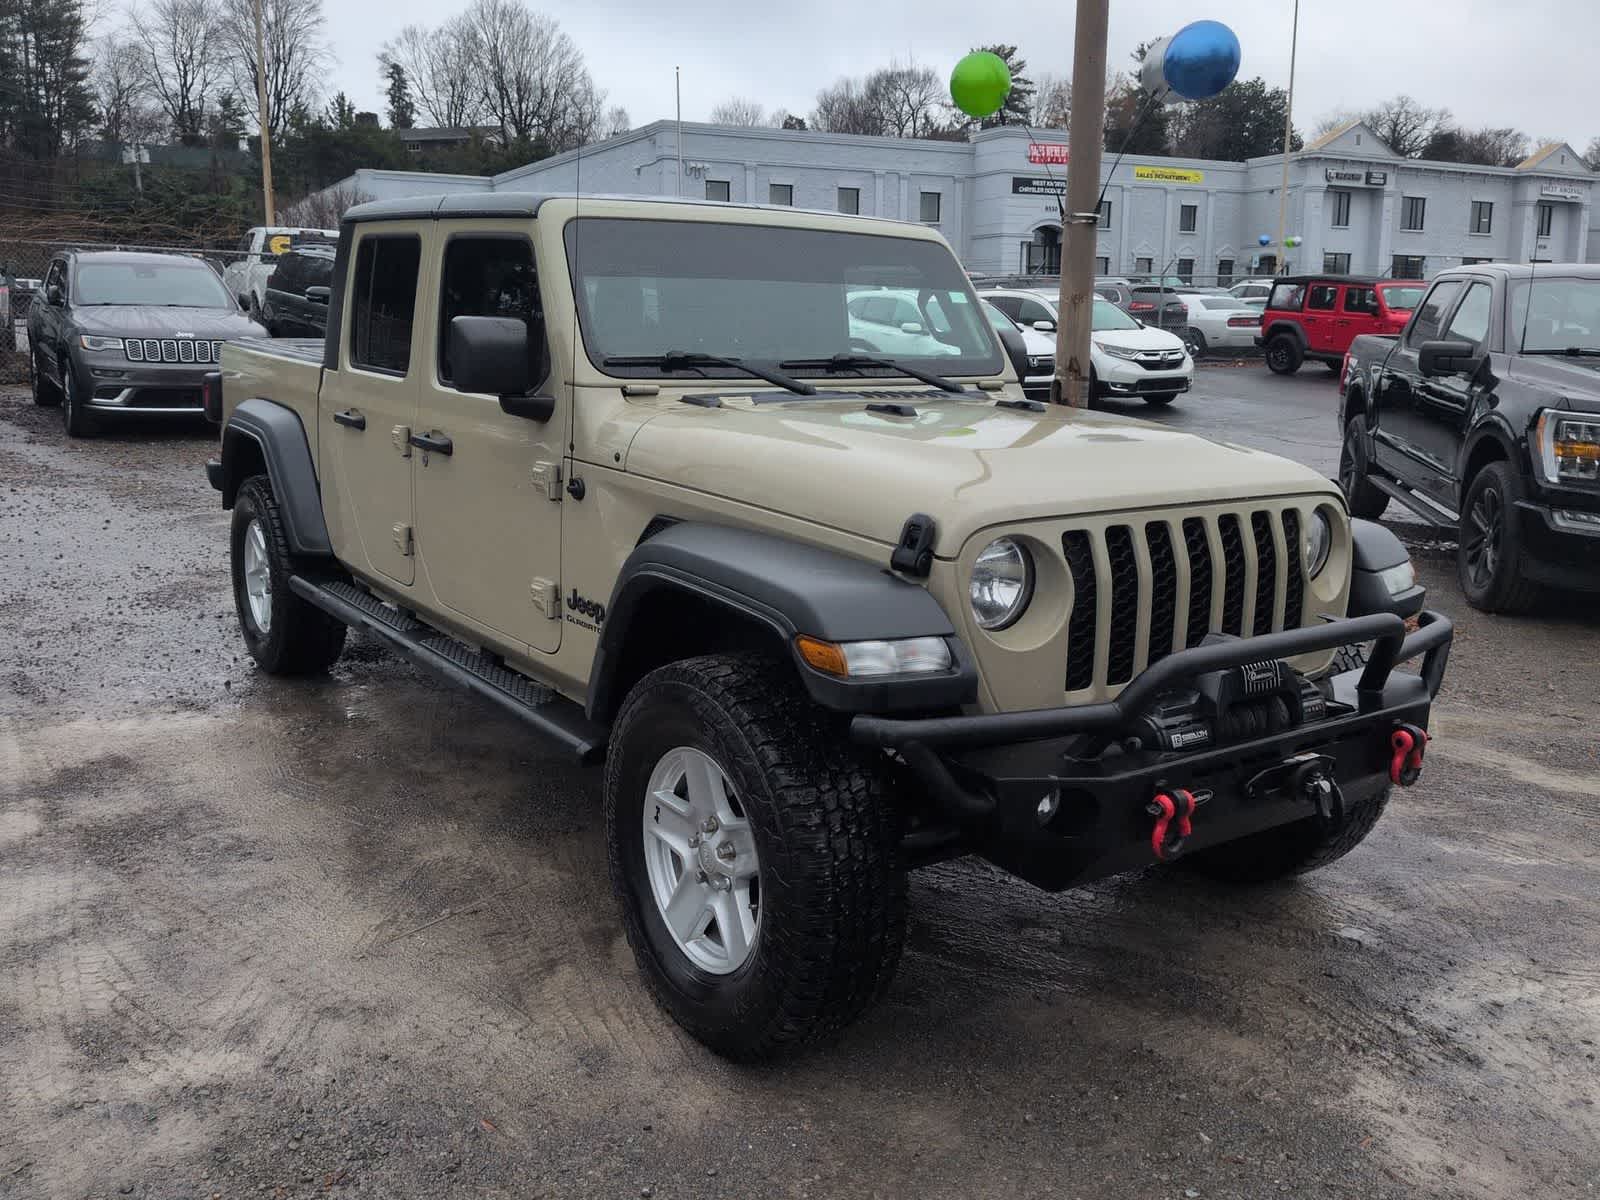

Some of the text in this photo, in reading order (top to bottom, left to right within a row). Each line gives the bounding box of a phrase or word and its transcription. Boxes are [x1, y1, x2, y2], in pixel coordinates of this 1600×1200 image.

[1136, 170, 1153, 178] SALES
[567, 588, 605, 624] Jeep
[567, 615, 600, 633] GLADIATO
